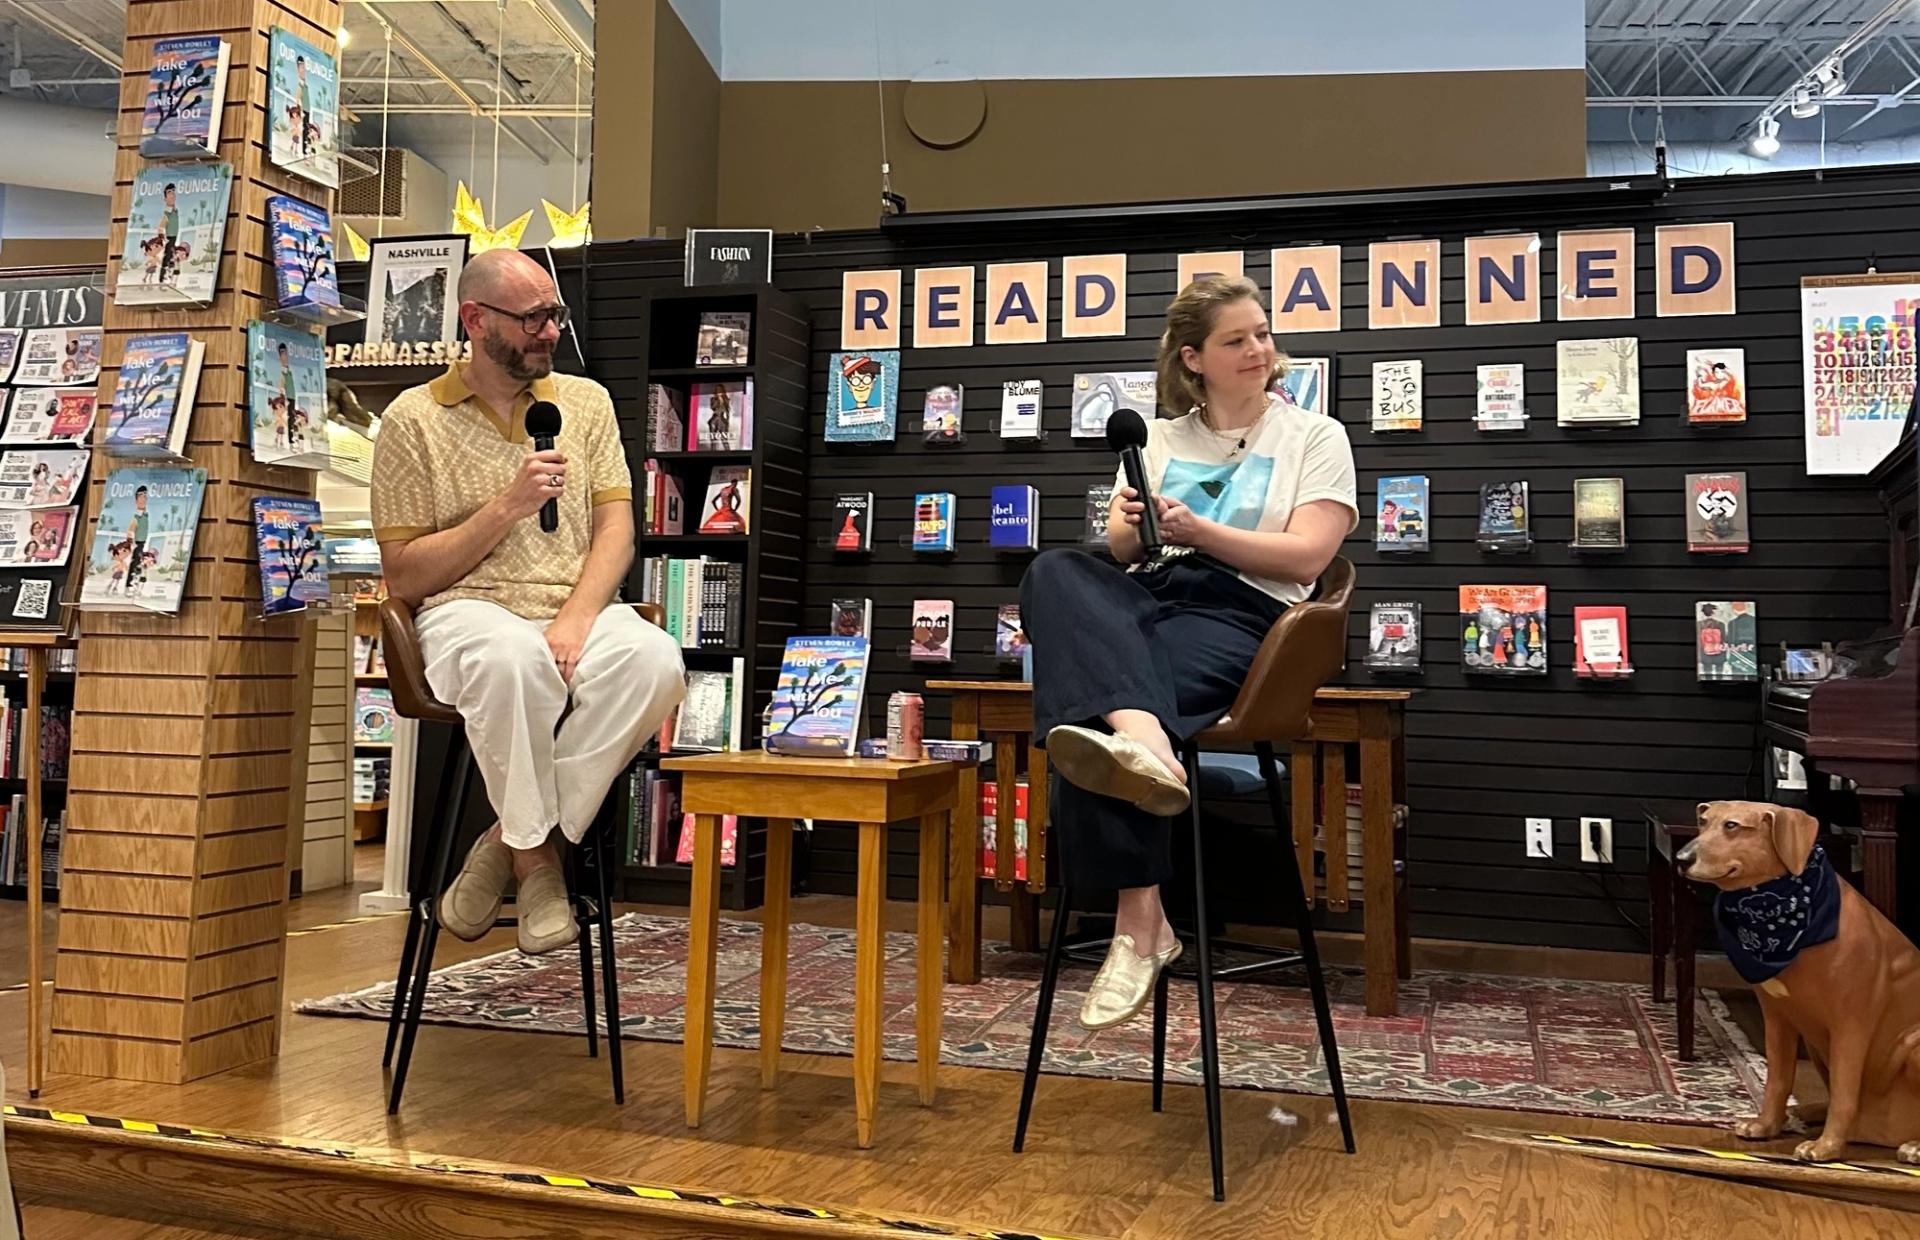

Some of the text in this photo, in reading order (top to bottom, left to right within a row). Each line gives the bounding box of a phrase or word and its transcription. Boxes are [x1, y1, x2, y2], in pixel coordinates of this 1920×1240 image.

[156, 59, 188, 72] Take
[279, 42, 333, 82] OUR GUNCLE
[175, 74, 196, 88] Me
[140, 178, 219, 196] OUR GUNCLE
[288, 217, 313, 235] Take
[388, 247, 451, 259] NASHVILLE
[710, 247, 752, 262] FASHION
[855, 246, 1722, 331] READ ANNED
[258, 334, 320, 361] OUR GUNCLE
[125, 356, 154, 369] Take
[1814, 354, 1837, 369] 10
[142, 373, 159, 386] Me
[1119, 377, 1154, 392] Tango
[1009, 388, 1041, 397] BLUME
[1379, 400, 1416, 416] BUS
[111, 483, 193, 498] OUR GUNCLE
[271, 515, 300, 530] Take
[292, 535, 311, 548] Me
[917, 620, 947, 628] PURPLE
[1378, 614, 1409, 625] GROUND
[790, 656, 827, 667] Take
[812, 673, 835, 685] Me
[872, 747, 887, 755] Tak
